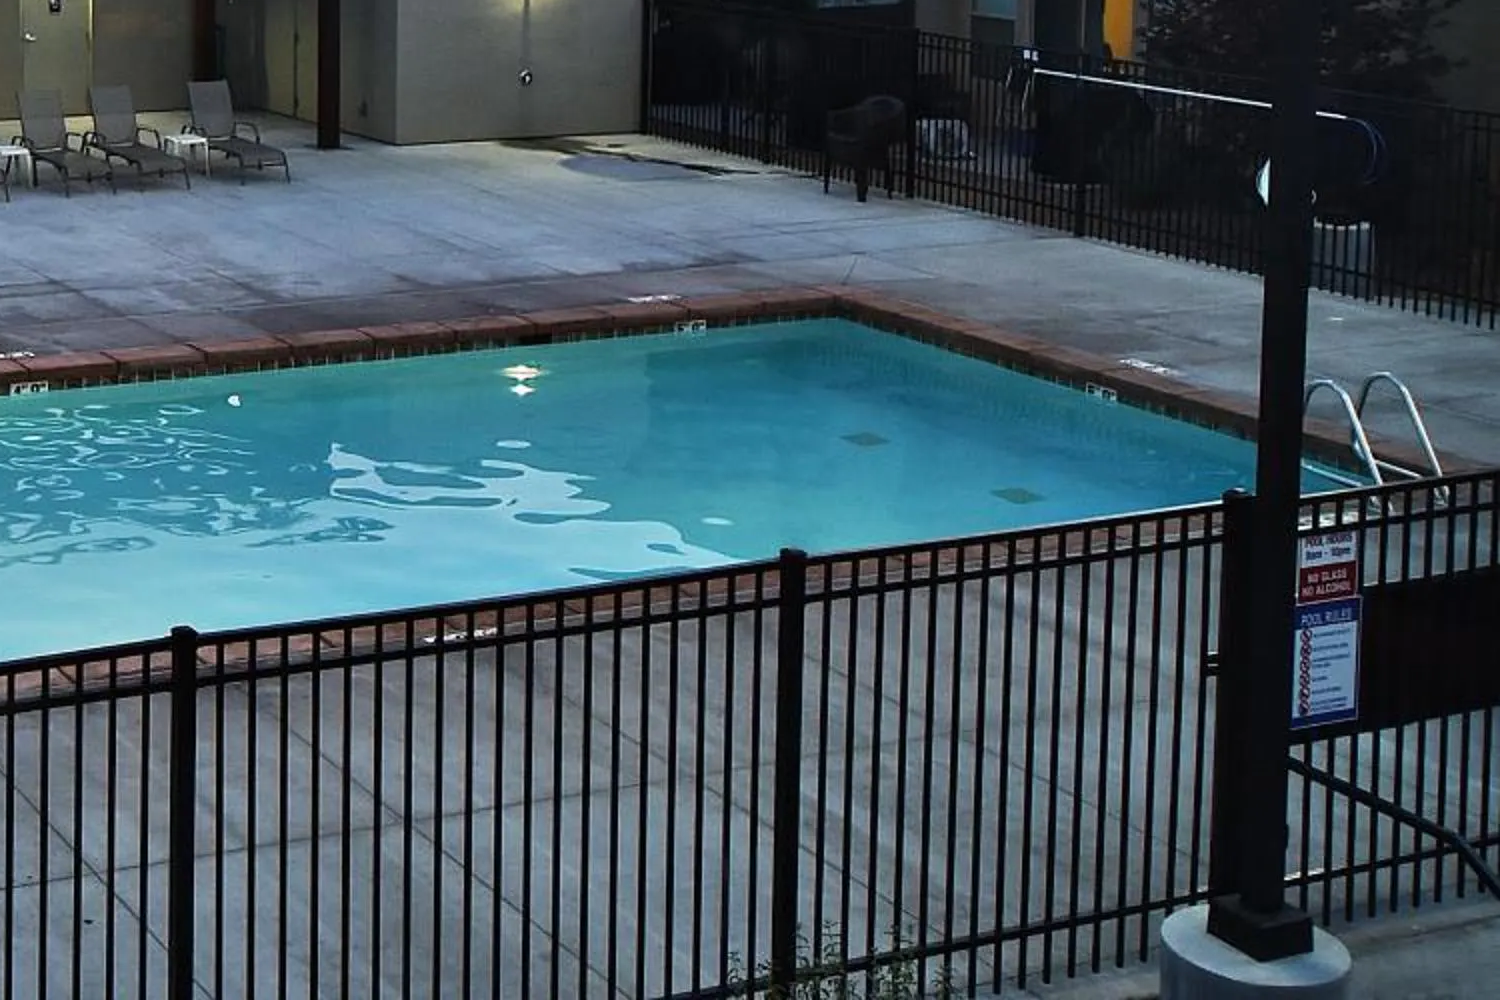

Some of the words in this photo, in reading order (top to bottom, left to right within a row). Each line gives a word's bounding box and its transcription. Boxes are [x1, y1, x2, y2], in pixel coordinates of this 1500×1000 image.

[1308, 573, 1319, 583] NO
[1321, 568, 1347, 581] GLASS
[1302, 586, 1315, 597] NO
[1315, 581, 1352, 595] ALCOHOL
[1301, 613, 1323, 626] POOL
